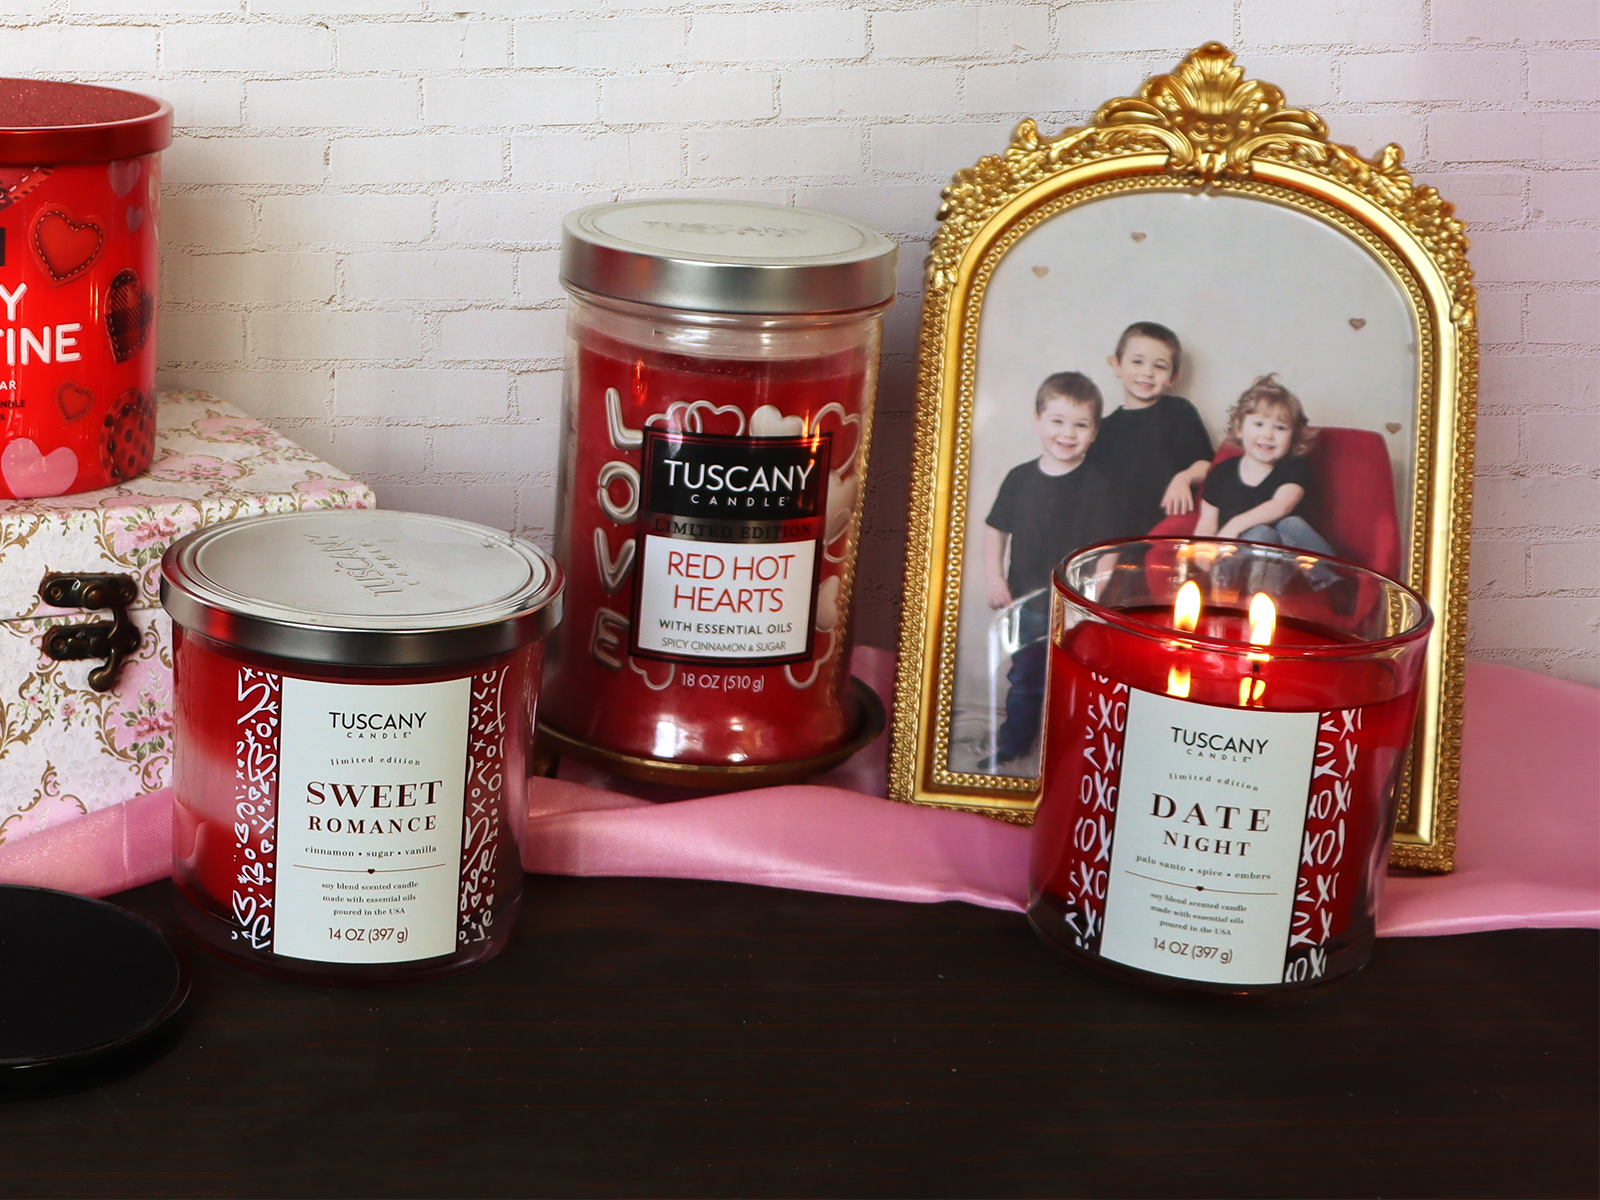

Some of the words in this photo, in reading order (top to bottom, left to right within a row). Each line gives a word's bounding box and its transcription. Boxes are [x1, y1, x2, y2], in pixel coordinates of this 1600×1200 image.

[663, 458, 814, 492] TUSCANY
[691, 494, 786, 507] CANDLE
[653, 518, 732, 539] LIMITED
[740, 522, 812, 539] EDITION
[667, 550, 725, 580] RED
[733, 554, 796, 581] HOT
[673, 584, 784, 613] HEARTS
[659, 619, 692, 632] WITH
[696, 621, 763, 635] ESSENTIAL
[767, 622, 793, 634] OILS
[662, 637, 690, 650] SPICY
[691, 640, 747, 652] CINNAMON
[756, 640, 787, 651] SUGAR
[681, 673, 696, 687] 18
[699, 674, 721, 688] OZ
[723, 674, 749, 692] (510
[751, 674, 765, 692] g)
[329, 711, 427, 730] TUSCANY
[347, 731, 411, 739] CANDLE
[1170, 726, 1269, 755] TUSCANY
[331, 756, 374, 766] limited
[380, 756, 421, 766] edition
[1187, 749, 1251, 763] CANDLE
[1169, 773, 1212, 783] limited
[1217, 778, 1260, 791] edition
[306, 780, 443, 808] SWEET
[1150, 792, 1272, 832] DATE
[308, 815, 437, 834] ROMANCE
[305, 846, 354, 857] cinnamon
[366, 850, 394, 859] sugar
[405, 845, 437, 855] vanilla
[1163, 830, 1251, 857] NIGHT
[1136, 854, 1157, 865] palo
[1159, 861, 1186, 872] santo
[1197, 867, 1224, 879] spice
[1234, 871, 1272, 880] embers
[321, 883, 335, 891] soy
[337, 882, 359, 891] blend
[361, 882, 392, 891] scented
[393, 880, 419, 889] candle
[323, 894, 344, 902] made
[347, 895, 364, 903] with
[366, 895, 401, 903] essential
[403, 894, 416, 902] oils
[1151, 893, 1163, 902] soy
[1165, 894, 1187, 907] blend
[1189, 899, 1220, 911] scented
[1221, 903, 1248, 912] candle
[333, 908, 362, 917] poured
[1151, 905, 1172, 914] made
[1173, 908, 1191, 918] with
[1193, 912, 1228, 922] essential
[1230, 915, 1245, 924] oils
[328, 928, 341, 940] 14
[344, 929, 365, 942] OZ
[367, 927, 394, 944] (397
[397, 927, 409, 944] g)
[1160, 919, 1188, 931] poured
[1199, 925, 1213, 933] the
[1214, 928, 1232, 936] USA
[1153, 937, 1166, 950] 14
[1169, 941, 1189, 956] OZ
[1191, 943, 1219, 961] (397
[1220, 947, 1233, 964] g)
